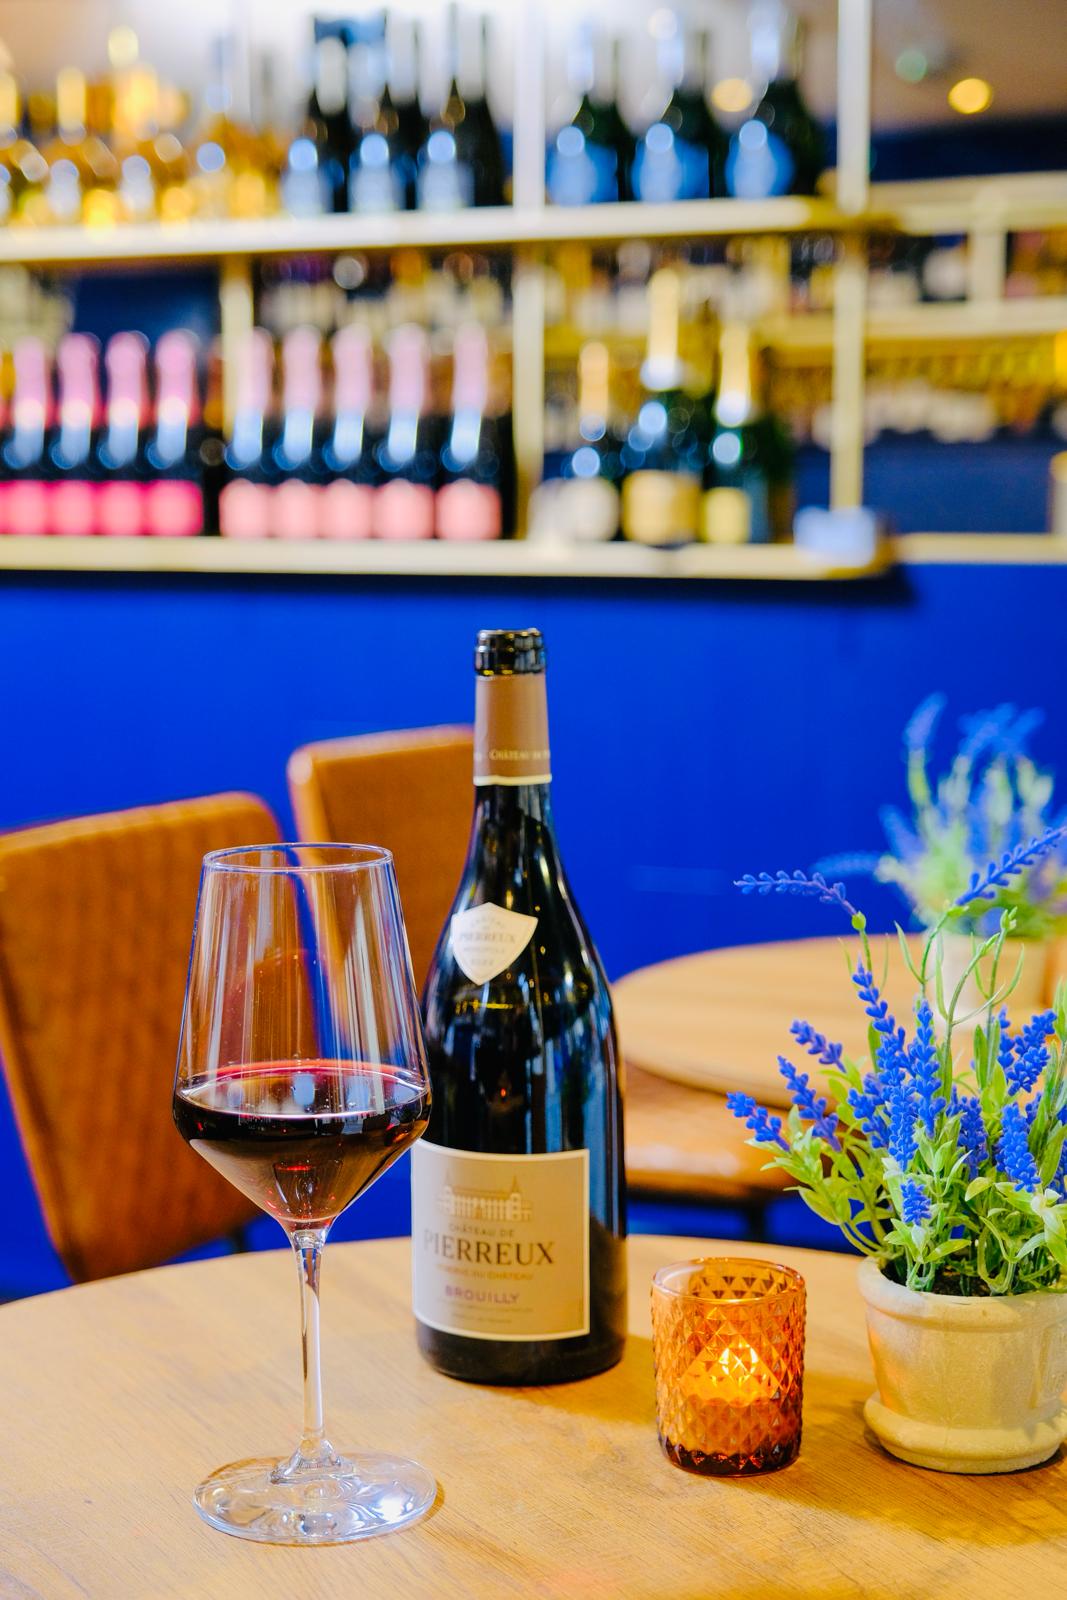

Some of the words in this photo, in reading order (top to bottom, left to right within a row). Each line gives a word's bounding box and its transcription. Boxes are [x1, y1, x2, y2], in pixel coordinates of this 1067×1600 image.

[500, 1229, 515, 1238] DE
[423, 1228, 556, 1266] PIERREUX
[445, 1285, 520, 1305] BROUILLY
